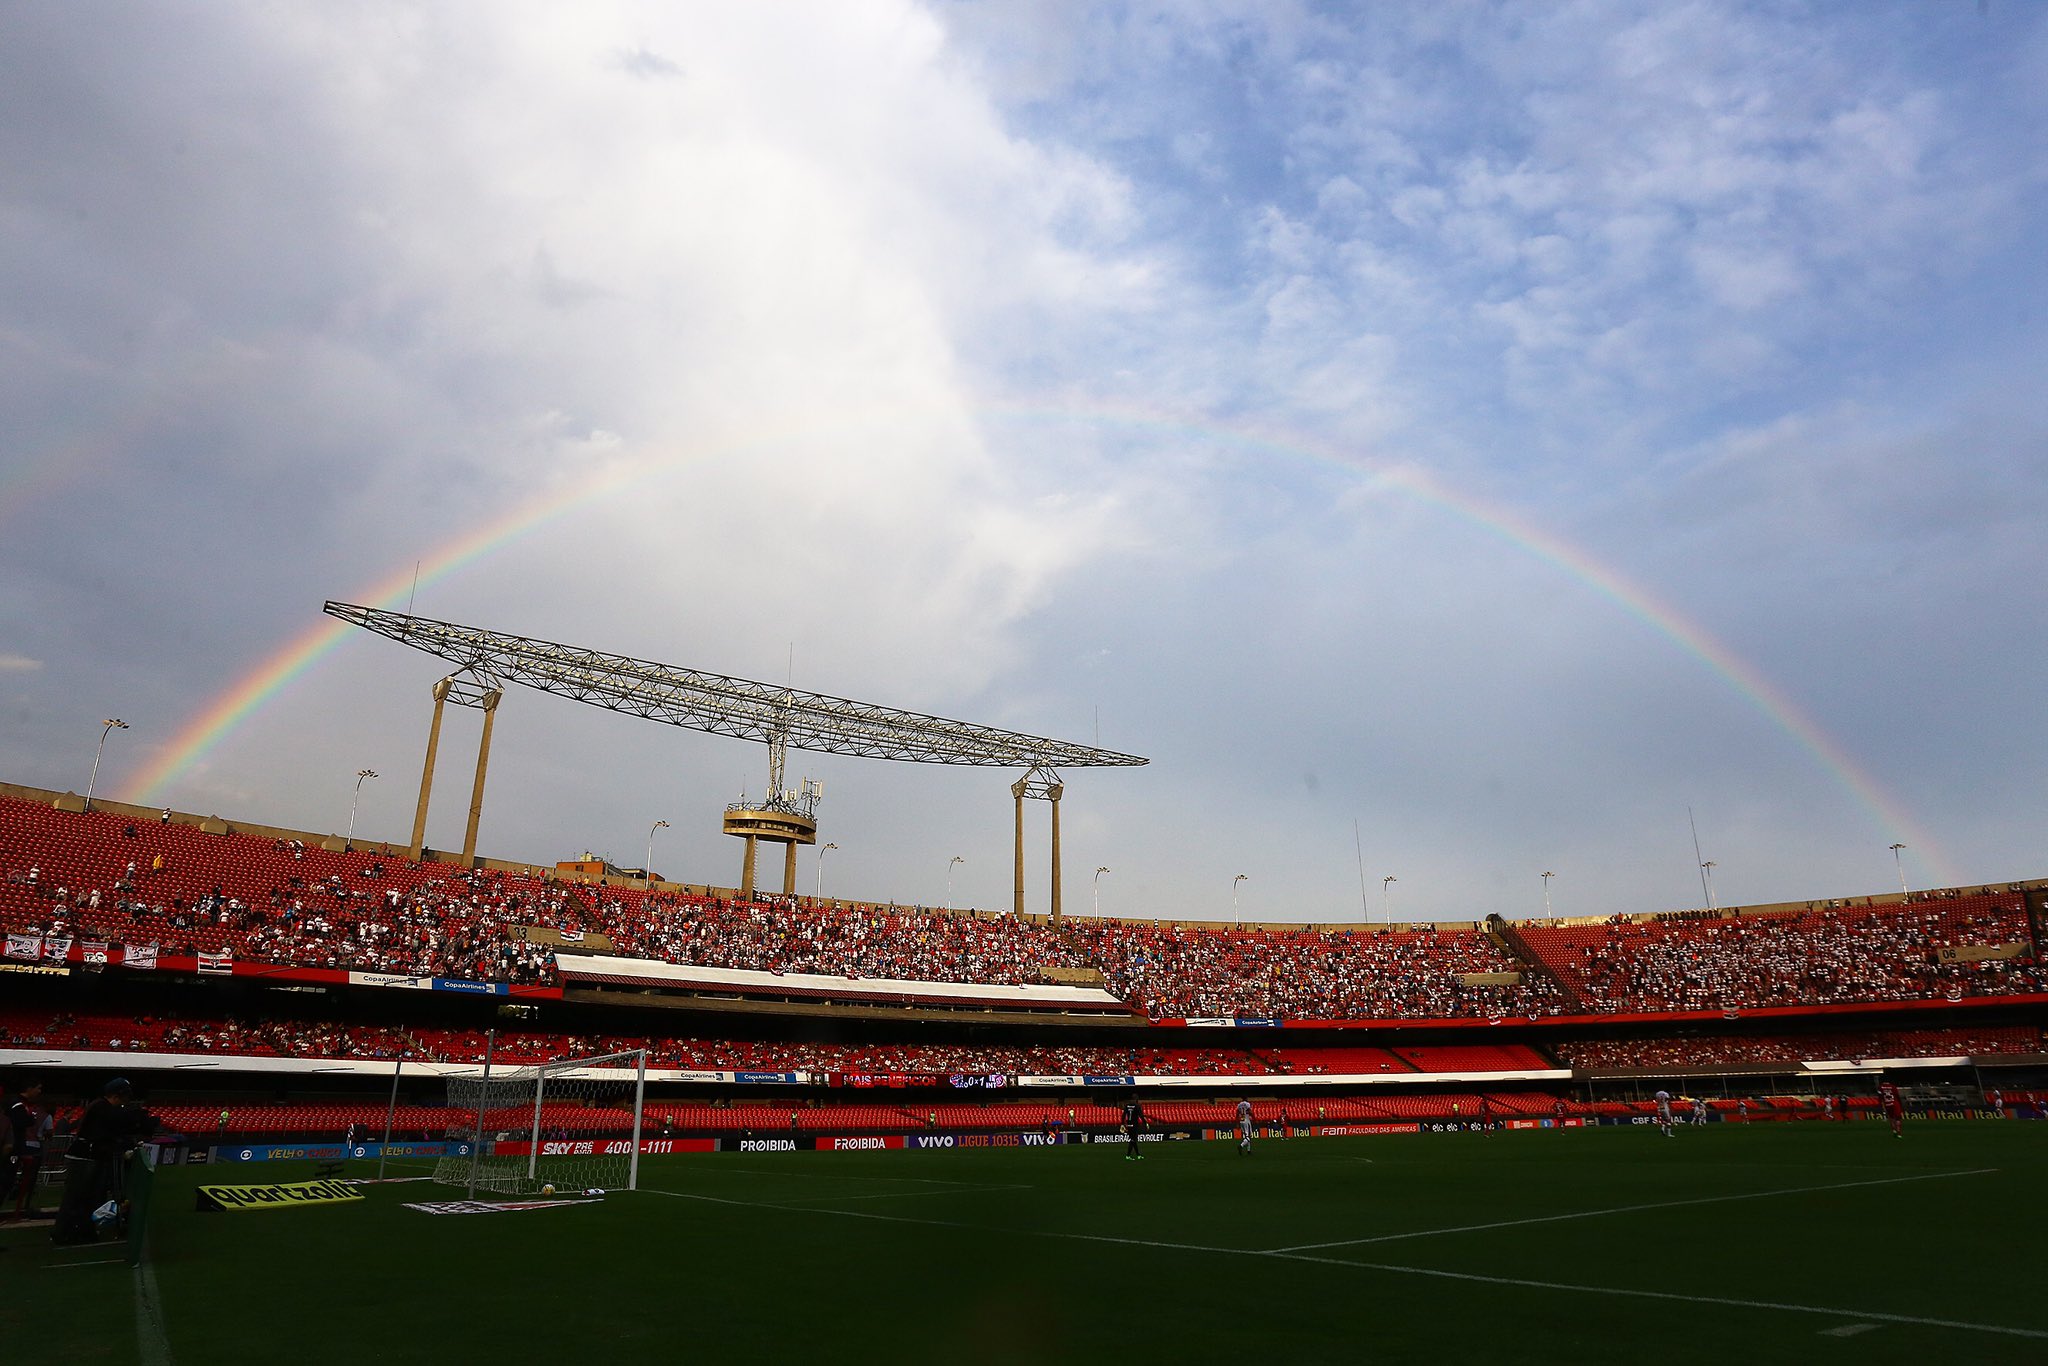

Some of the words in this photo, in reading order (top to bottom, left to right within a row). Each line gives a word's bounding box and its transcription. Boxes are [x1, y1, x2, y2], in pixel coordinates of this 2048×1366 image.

[1942, 949, 1956, 960] 06
[443, 981, 486, 992] CopaAirlines
[680, 1072, 716, 1081] CopaAirlines
[743, 1073, 778, 1082] CopaAirlines
[1631, 1116, 1650, 1125] CBF
[1651, 1115, 1686, 1125] SIAL
[1936, 1108, 1964, 1120] Itaú
[1215, 1128, 1233, 1140] Itaú
[1293, 1126, 1310, 1138] Itaú
[1348, 1126, 1379, 1135] FACULDADE
[1379, 1126, 1391, 1134] DAS
[604, 1140, 673, 1154] 400-1111
[918, 1136, 954, 1148] VIVO
[957, 1135, 989, 1148] LIGUE
[991, 1134, 1020, 1147] 10315
[541, 1142, 575, 1155] SKY
[207, 1179, 362, 1207] quartzolit
